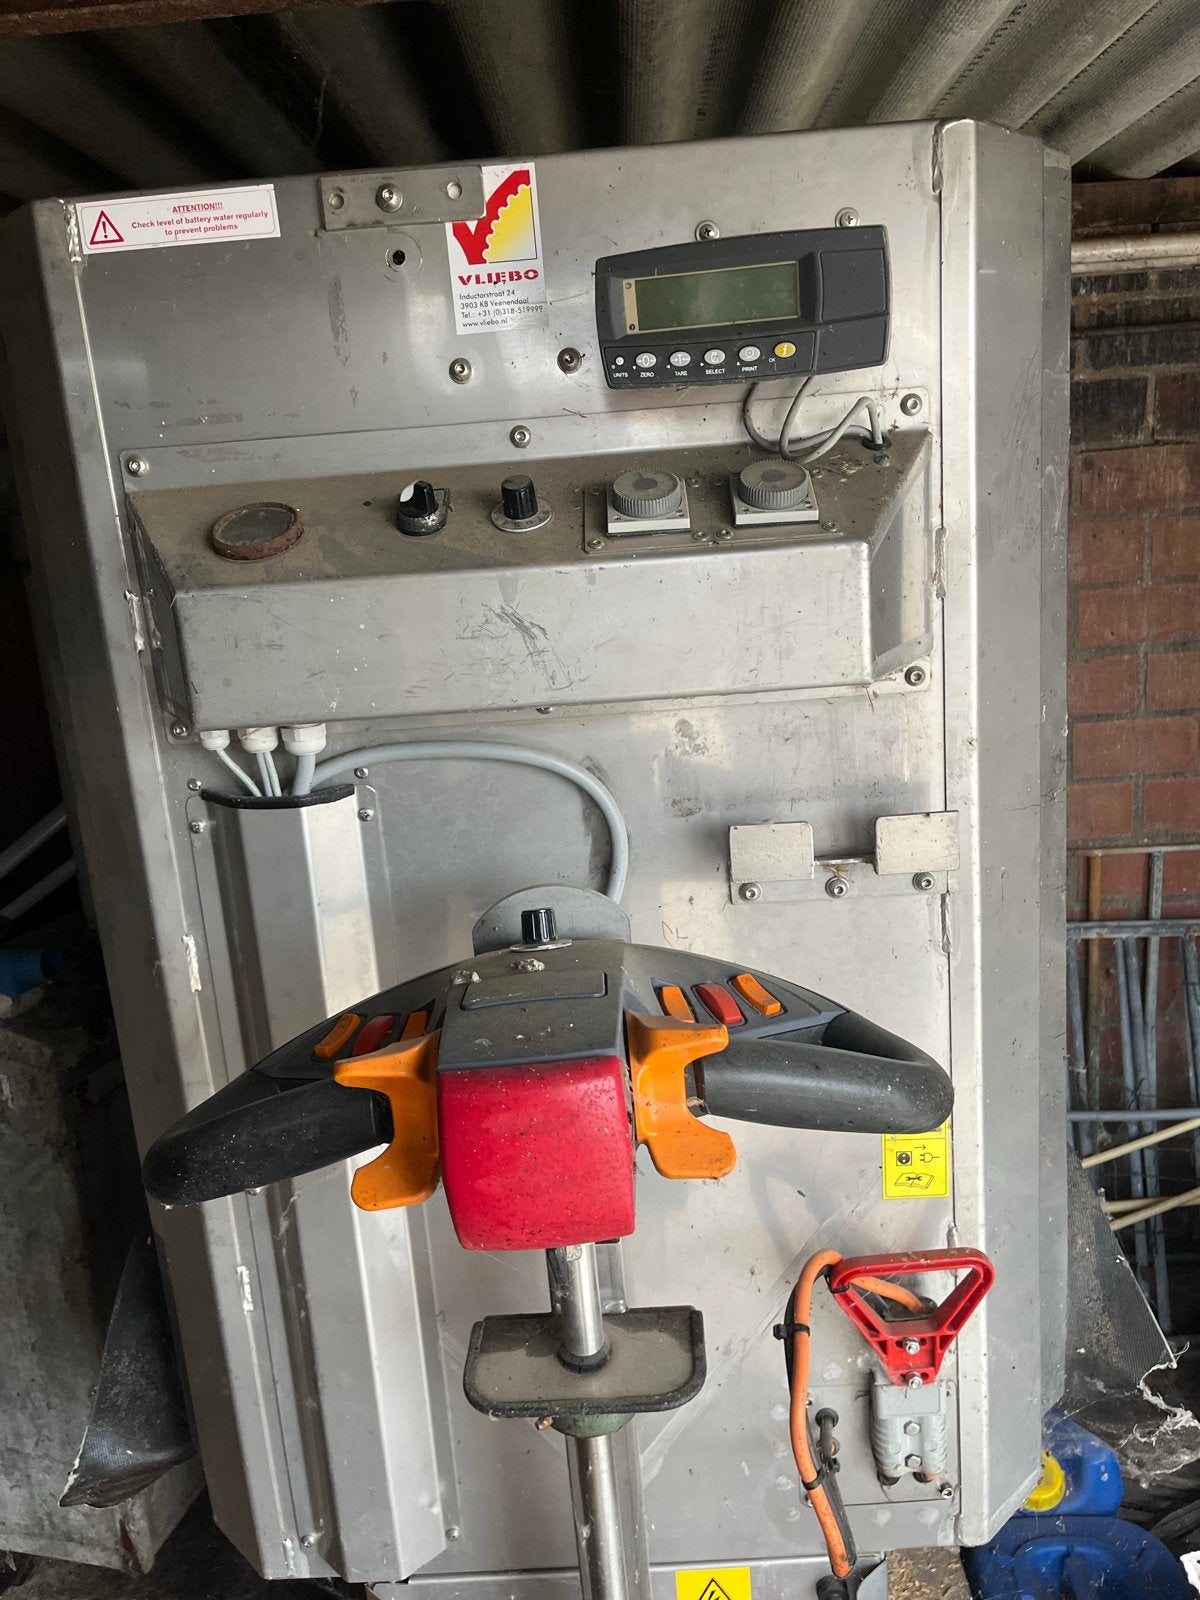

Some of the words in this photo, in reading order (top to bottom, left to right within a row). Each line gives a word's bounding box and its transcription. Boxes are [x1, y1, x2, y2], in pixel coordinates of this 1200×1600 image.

[172, 202, 223, 214] ATTENTION!!!
[131, 220, 154, 229] Check
[156, 217, 174, 227] level
[176, 216, 183, 225] of
[185, 214, 211, 225] battery
[213, 212, 234, 222] water
[235, 210, 268, 220] regularly
[174, 225, 202, 236] prevent
[203, 223, 239, 233] problems
[459, 291, 505, 300] Inductorstraat
[460, 301, 478, 309] 3903
[480, 300, 489, 308] KB
[490, 297, 529, 307] Veenendaal
